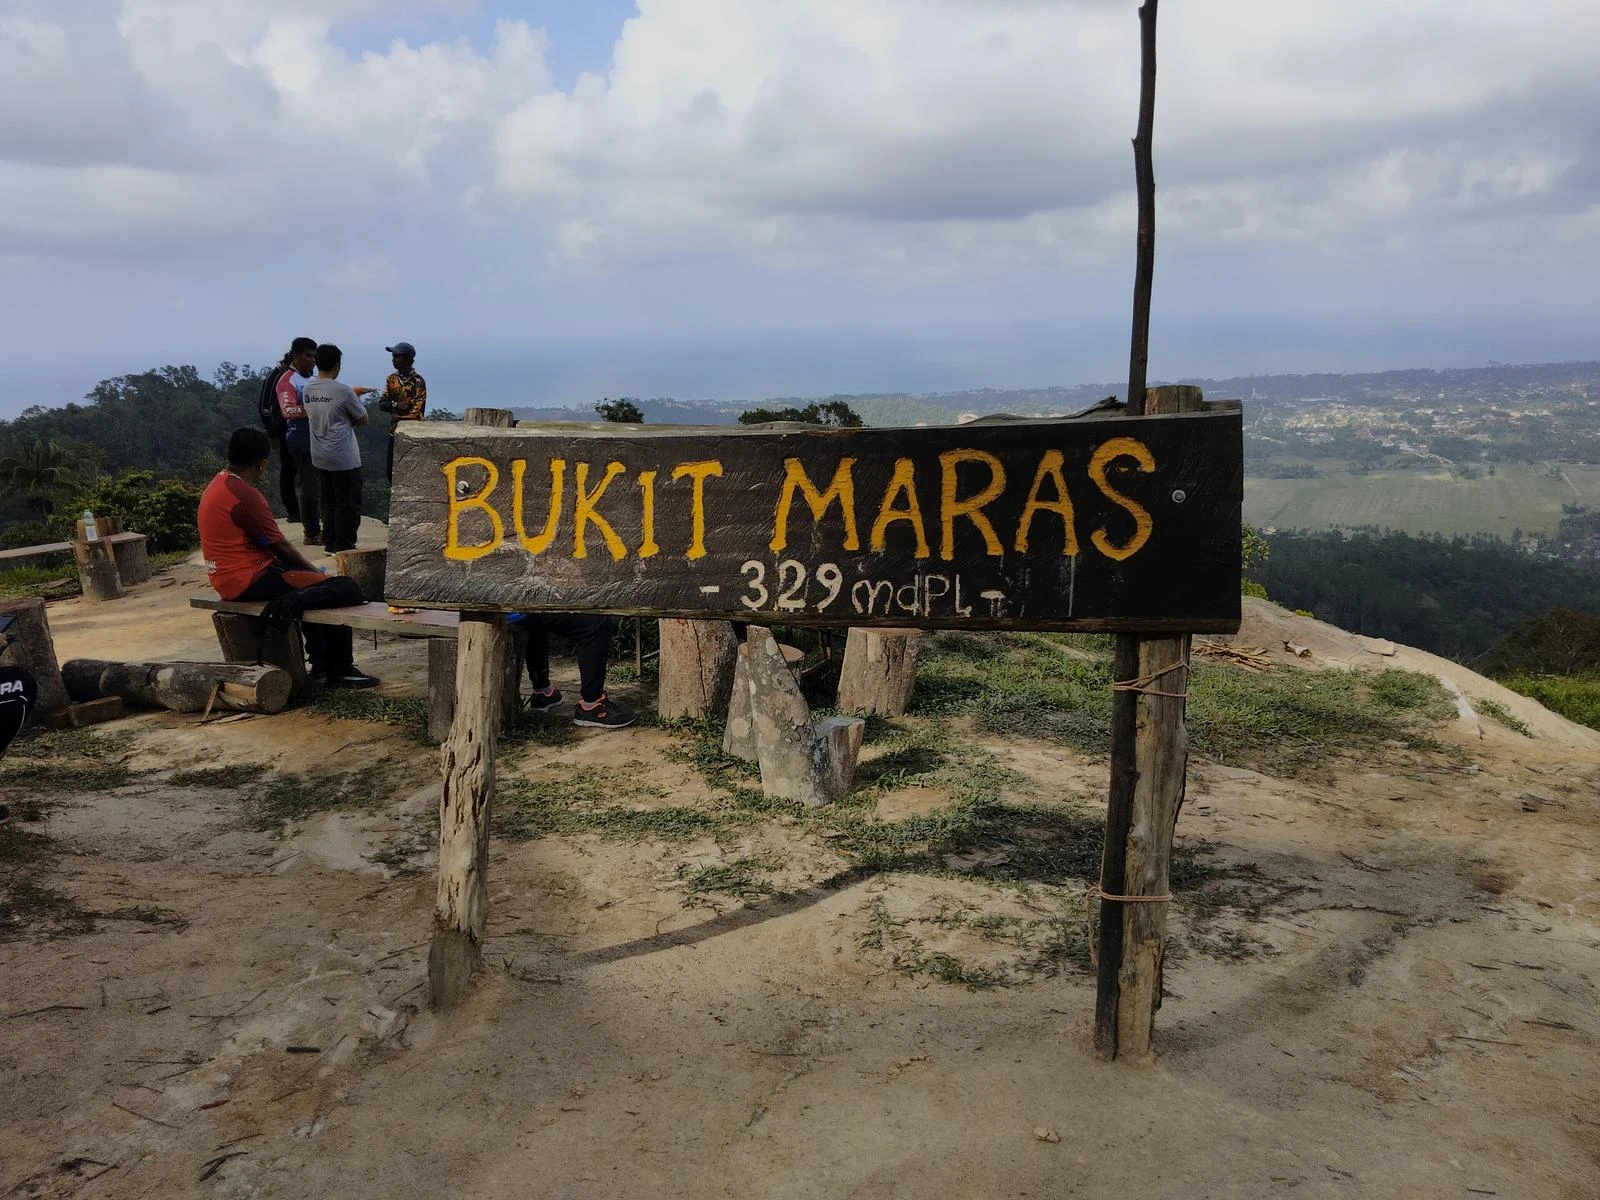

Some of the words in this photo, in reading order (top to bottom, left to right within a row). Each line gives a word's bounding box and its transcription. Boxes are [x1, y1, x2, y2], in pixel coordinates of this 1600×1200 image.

[442, 456, 723, 561] BUKIT
[770, 437, 1156, 561] MARAS
[740, 559, 844, 612] 329
